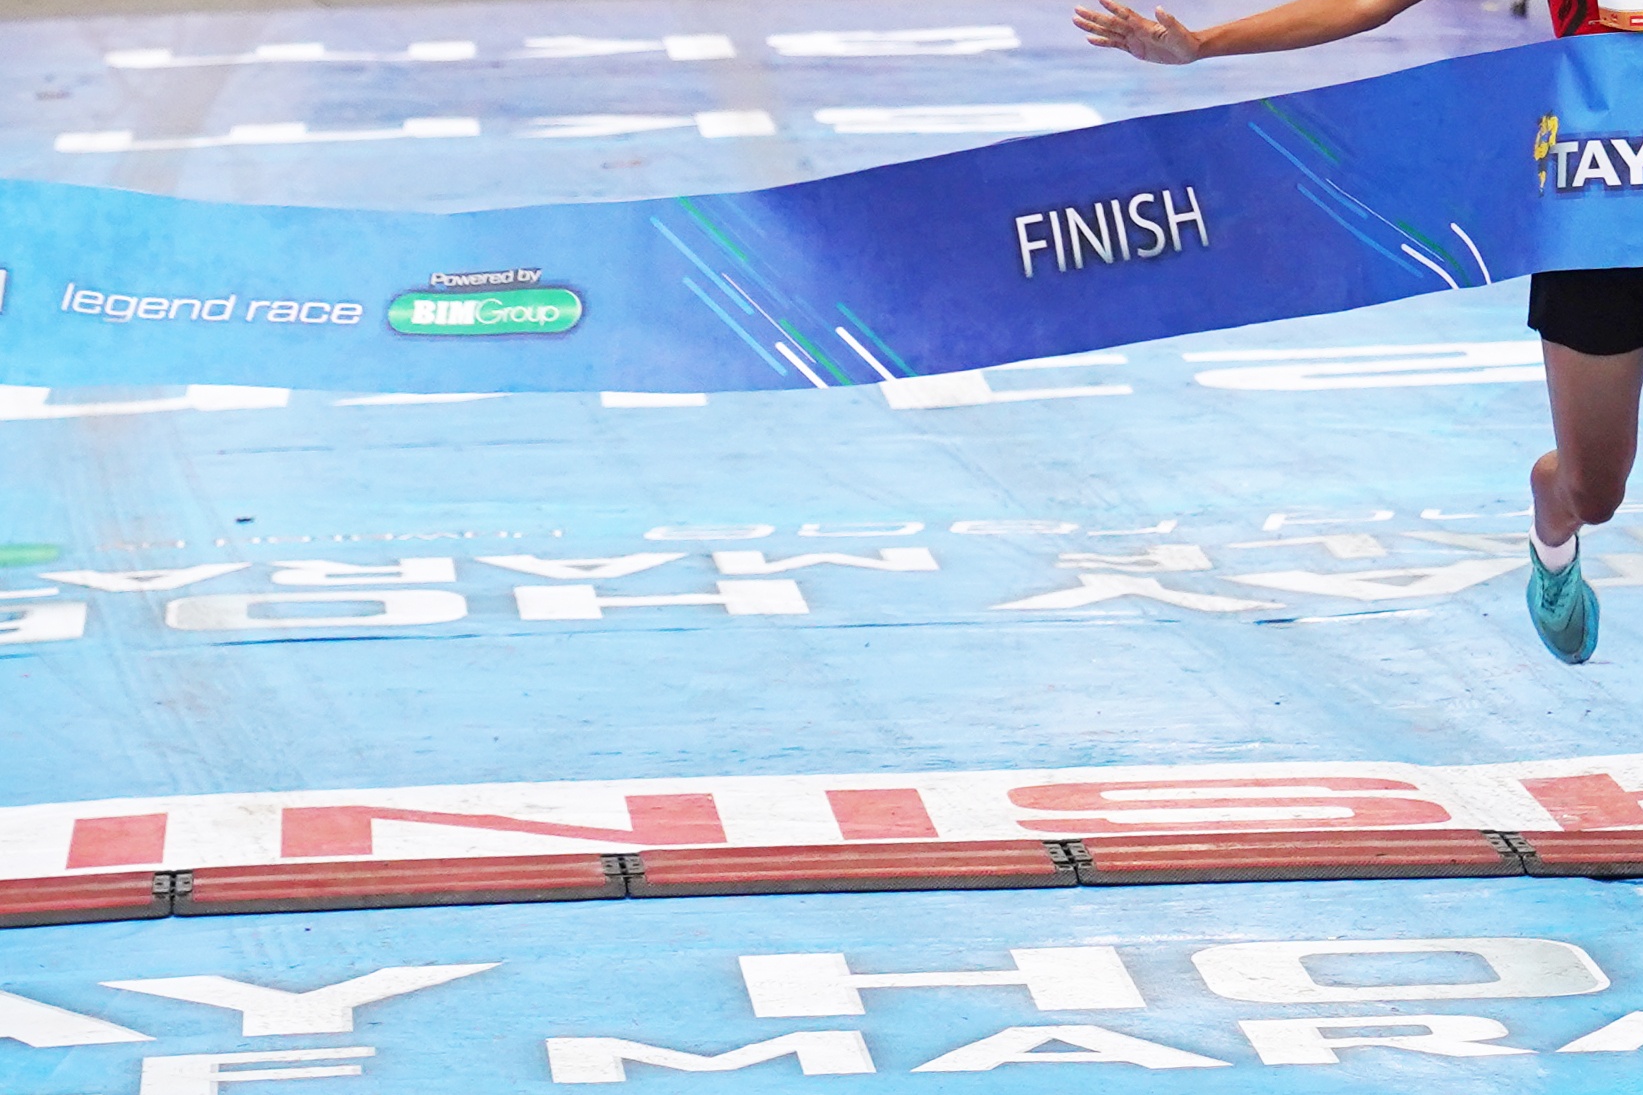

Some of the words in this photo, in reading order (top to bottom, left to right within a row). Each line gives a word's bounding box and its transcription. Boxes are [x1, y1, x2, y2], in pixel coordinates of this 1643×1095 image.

[1013, 184, 1210, 279] FINISH
[60, 281, 236, 324] legend
[243, 298, 364, 326] race
[429, 269, 515, 287] Powered
[516, 267, 543, 283] by
[738, 936, 1611, 1019] HO
